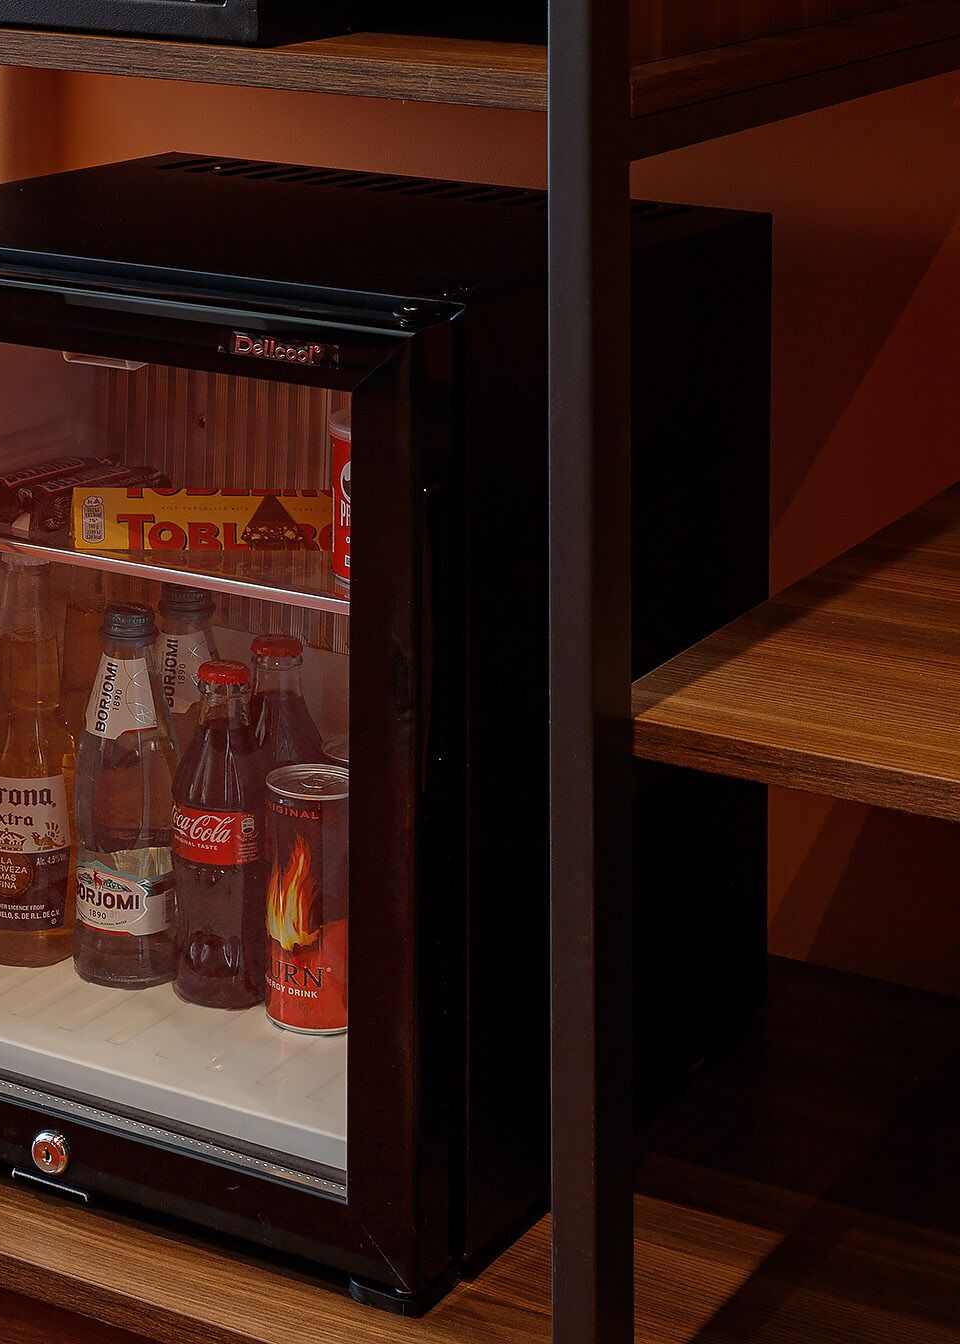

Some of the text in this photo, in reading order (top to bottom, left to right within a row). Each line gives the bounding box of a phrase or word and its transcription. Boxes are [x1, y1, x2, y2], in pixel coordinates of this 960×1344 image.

[178, 664, 186, 684] 1890
[95, 662, 118, 732] BORJOMI
[112, 689, 122, 711] 1890
[0, 857, 13, 865] LA
[89, 909, 106, 919] 1890
[288, 987, 317, 998] DRINK
